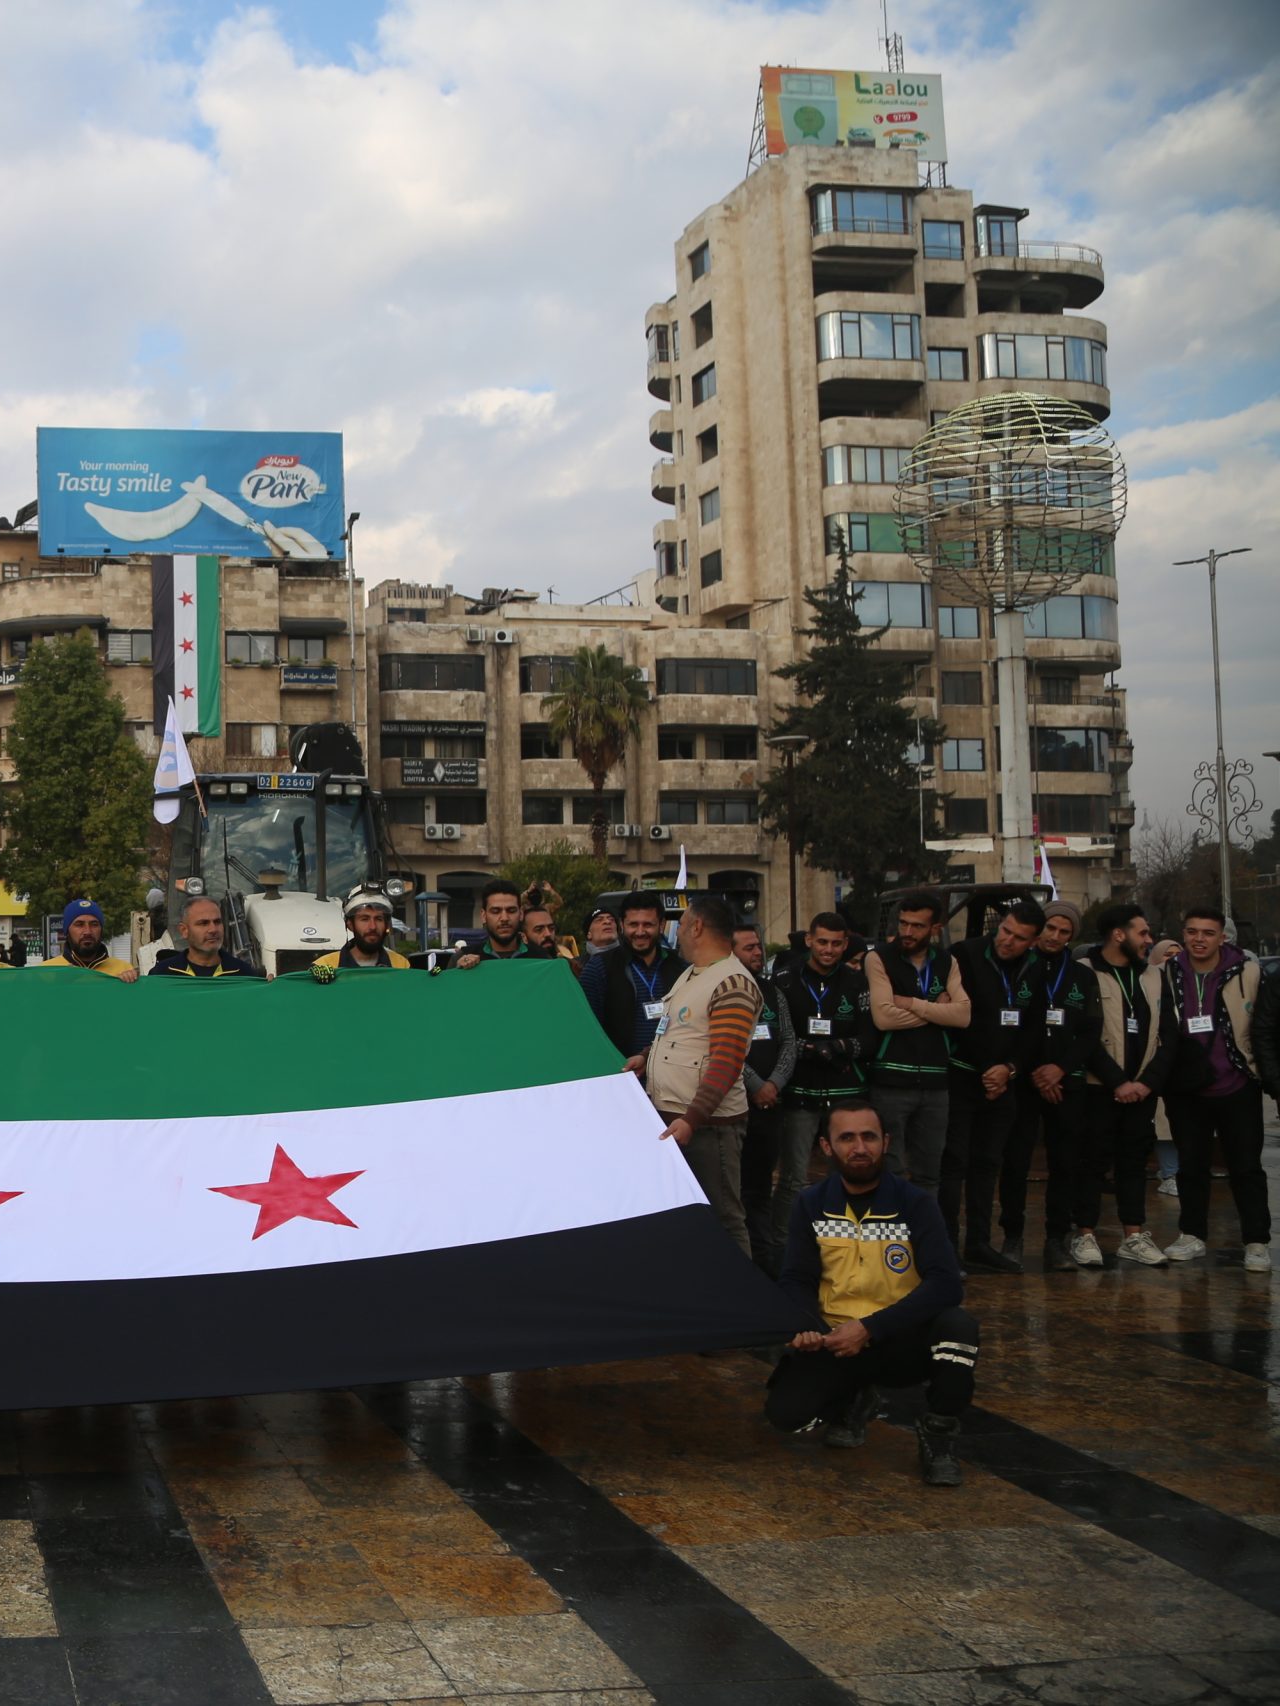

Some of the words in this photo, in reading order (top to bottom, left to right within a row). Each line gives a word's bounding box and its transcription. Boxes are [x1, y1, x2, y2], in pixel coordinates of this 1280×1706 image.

[854, 72, 928, 97] Laalou
[892, 113, 911, 121] 9799
[264, 455, 294, 466] نيوبارك
[79, 460, 103, 471] Your
[105, 461, 150, 474] morning
[276, 469, 303, 481] New
[56, 472, 112, 497] Tasty
[116, 472, 173, 493] smile
[247, 473, 312, 501] Park
[401, 724, 426, 733] TRADING
[260, 776, 270, 787] D2
[666, 898, 679, 907] D2
